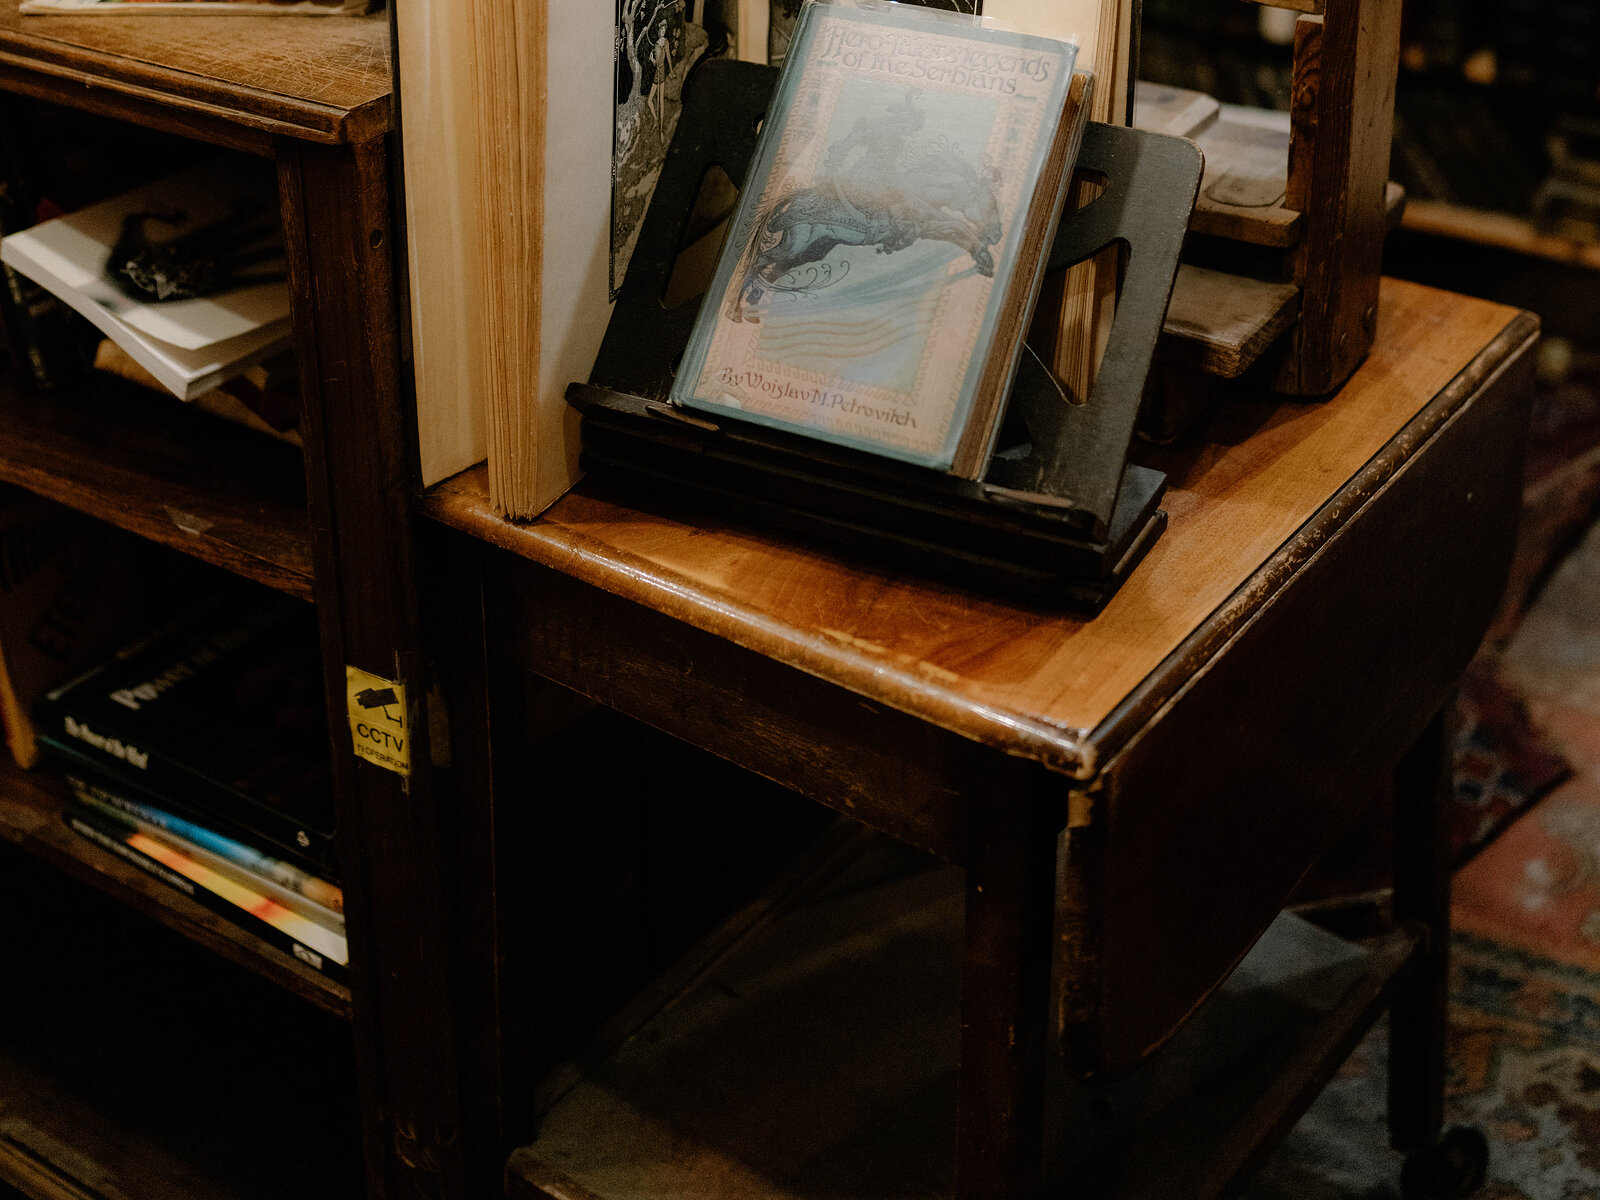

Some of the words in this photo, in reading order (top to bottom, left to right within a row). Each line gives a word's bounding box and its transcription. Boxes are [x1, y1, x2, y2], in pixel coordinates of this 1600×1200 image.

[842, 49, 868, 72] of
[872, 52, 908, 76] the
[908, 58, 1018, 96] Serbians
[960, 44, 1050, 83] Legends
[719, 366, 745, 388] By
[743, 369, 811, 400] Woislav
[830, 393, 918, 429] Petrovitch
[356, 723, 404, 753] CCTV
[357, 743, 365, 753] IN
[364, 746, 409, 770] OPERATION
